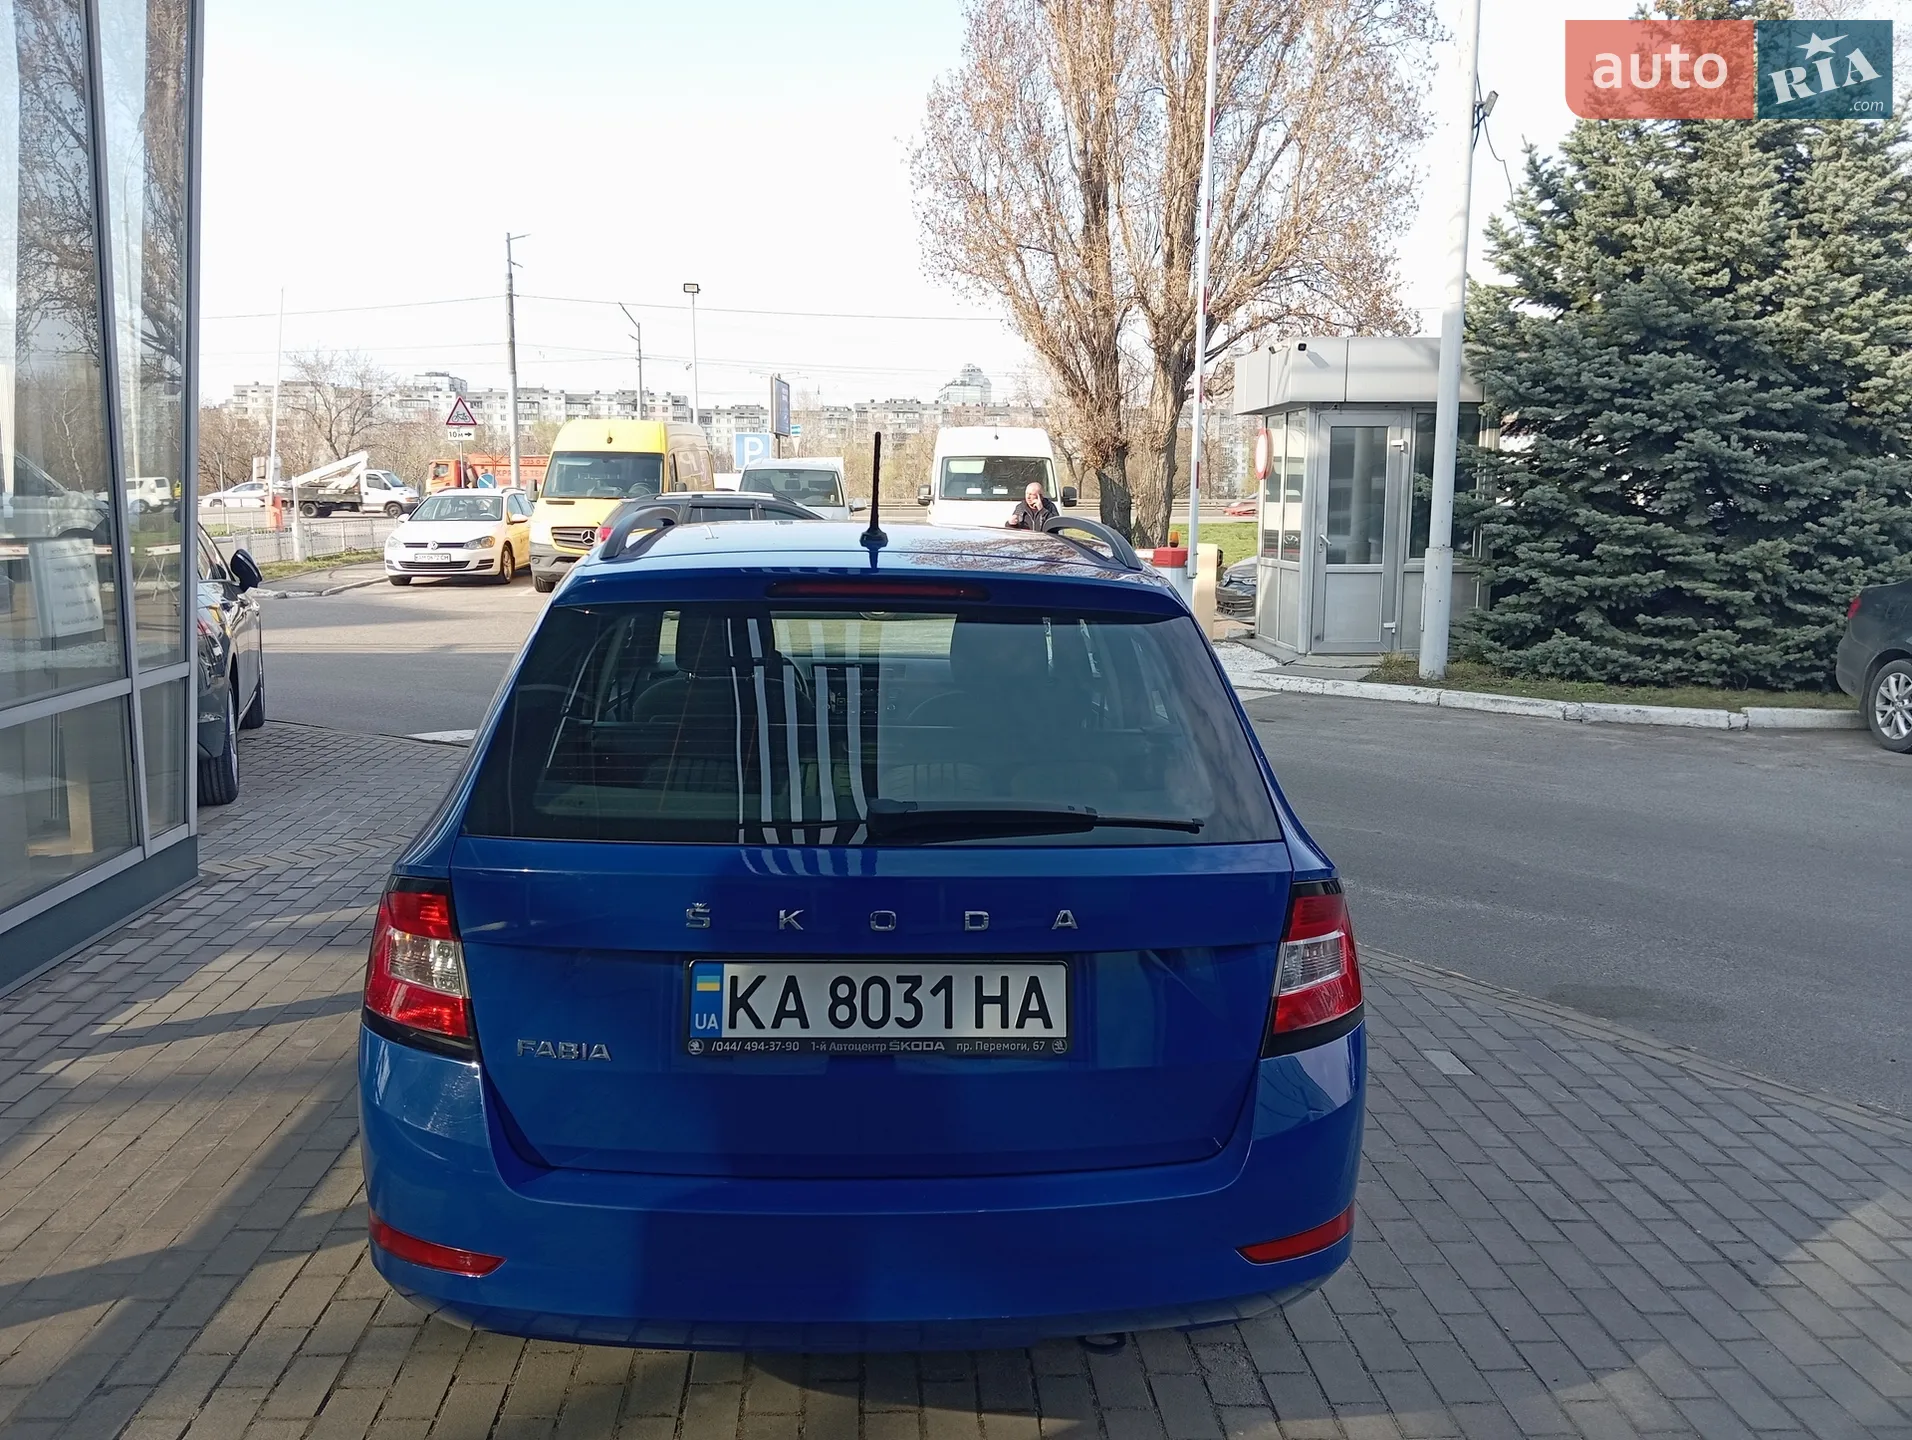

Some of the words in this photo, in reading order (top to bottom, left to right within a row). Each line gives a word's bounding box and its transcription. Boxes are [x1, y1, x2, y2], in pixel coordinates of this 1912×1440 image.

[685, 902, 1079, 932] ŠKODA
[728, 975, 810, 1030] KA
[828, 975, 953, 1030] 8031
[974, 975, 1054, 1030] HA
[695, 1013, 719, 1030] UA
[517, 1039, 612, 1061] FABIA
[711, 1041, 741, 1051] /044/
[744, 1041, 800, 1051] 494-37-90
[811, 1041, 827, 1051] 1-й
[829, 1041, 887, 1053] Автоцентр
[956, 1042, 972, 1053] пр.
[975, 1041, 1030, 1053] Перемоги,
[1032, 1041, 1046, 1051] 67
